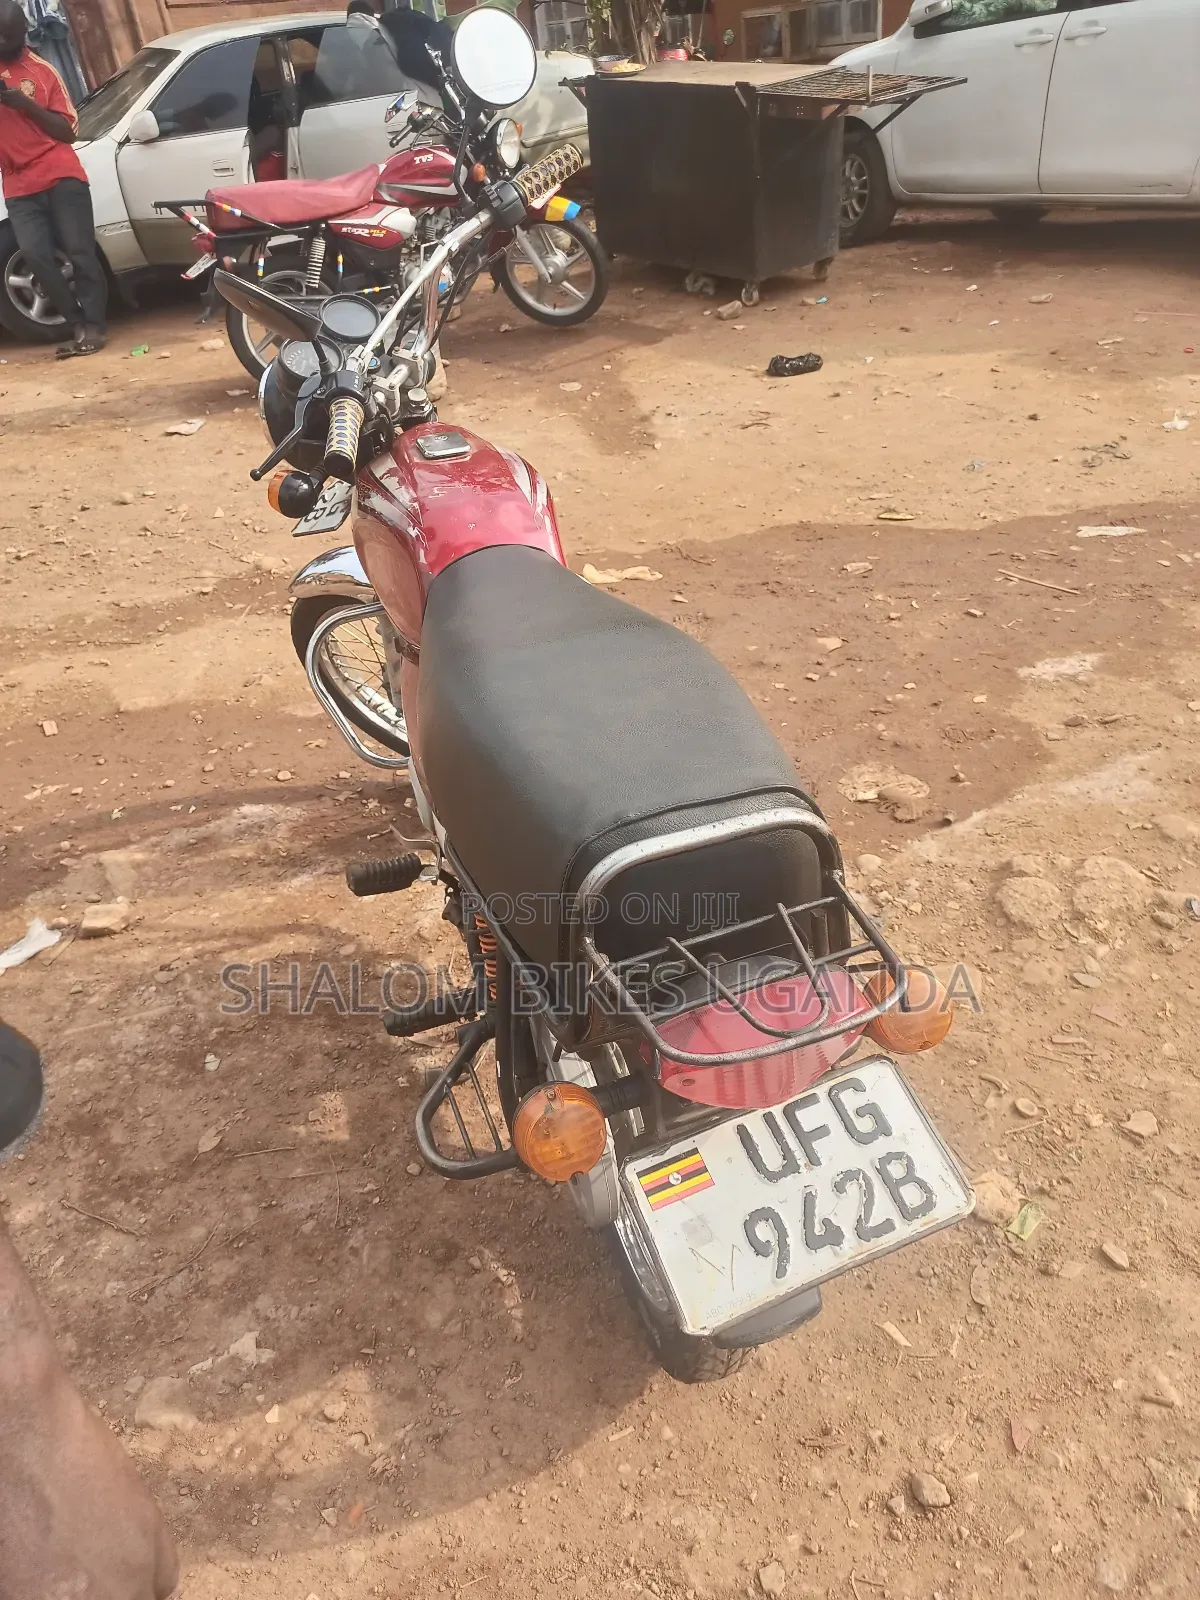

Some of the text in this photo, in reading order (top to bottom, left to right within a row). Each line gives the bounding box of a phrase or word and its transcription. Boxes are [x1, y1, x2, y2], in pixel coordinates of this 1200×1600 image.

[413, 153, 434, 165] TVS
[736, 1076, 893, 1184] UFG
[743, 1151, 939, 1280] 942B
